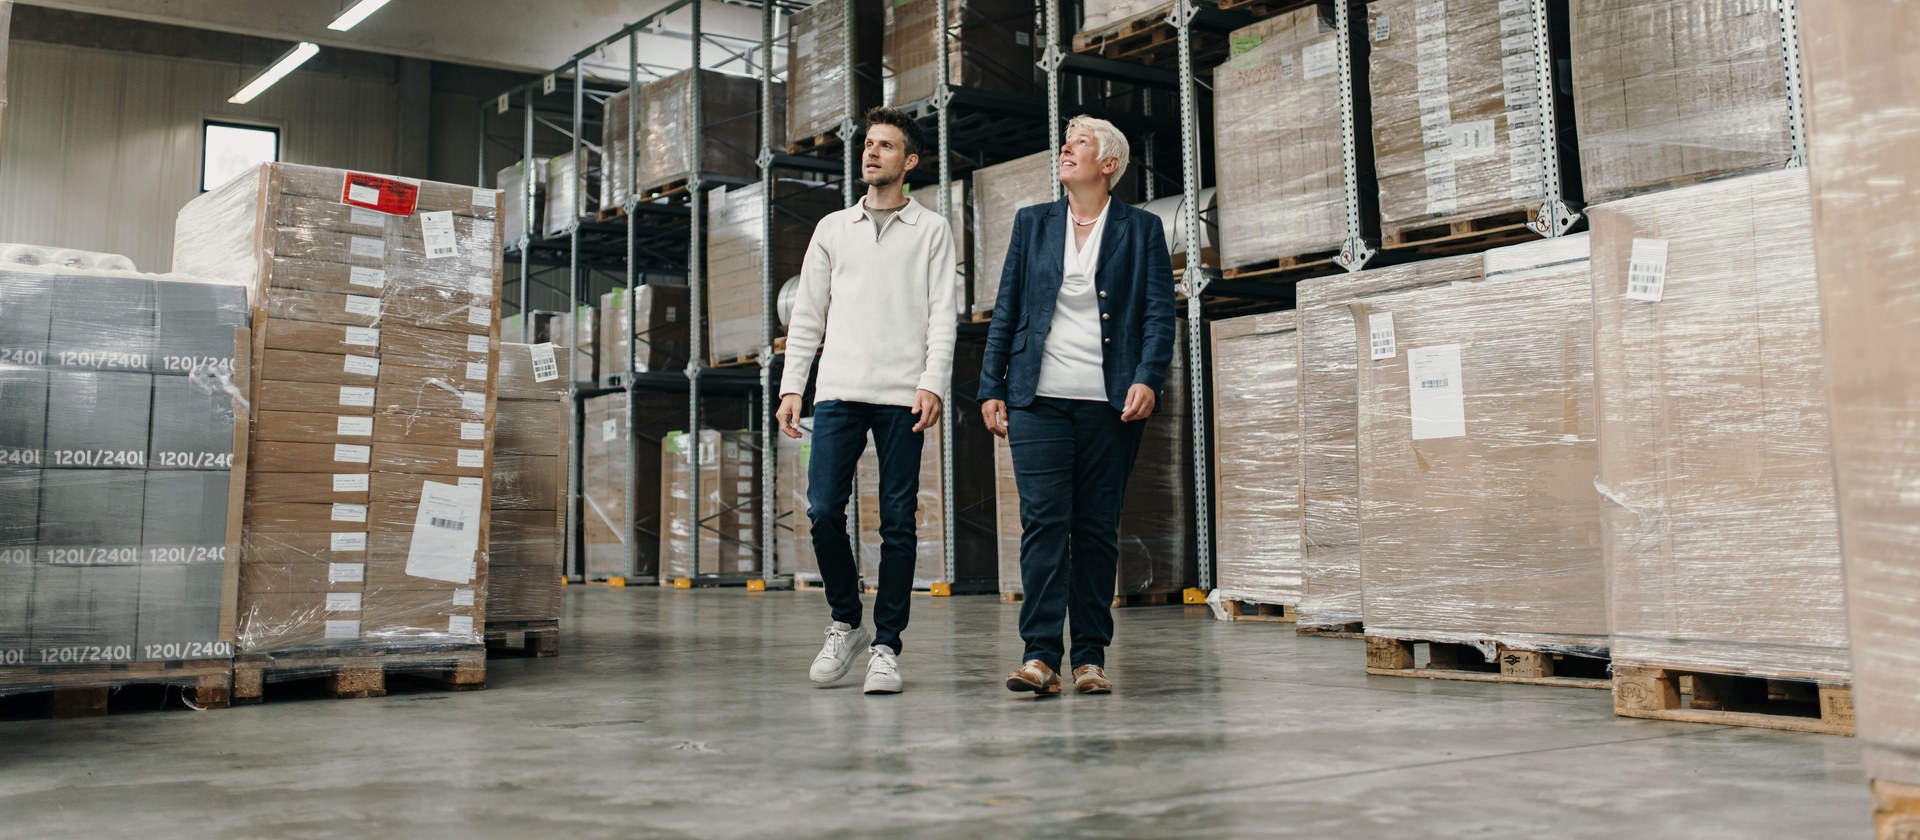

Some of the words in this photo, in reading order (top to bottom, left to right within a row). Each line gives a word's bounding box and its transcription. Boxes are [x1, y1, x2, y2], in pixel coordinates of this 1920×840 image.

[59, 351, 148, 369] 120l/240l
[163, 356, 235, 373] 120l/24
[54, 450, 144, 466] 120l/240l
[159, 452, 234, 467] 120l/240
[48, 548, 137, 564] 120l/240l
[40, 645, 131, 664] 120l/240l
[145, 641, 231, 659] 120l/240l
[1621, 686, 1645, 699] EPAL
